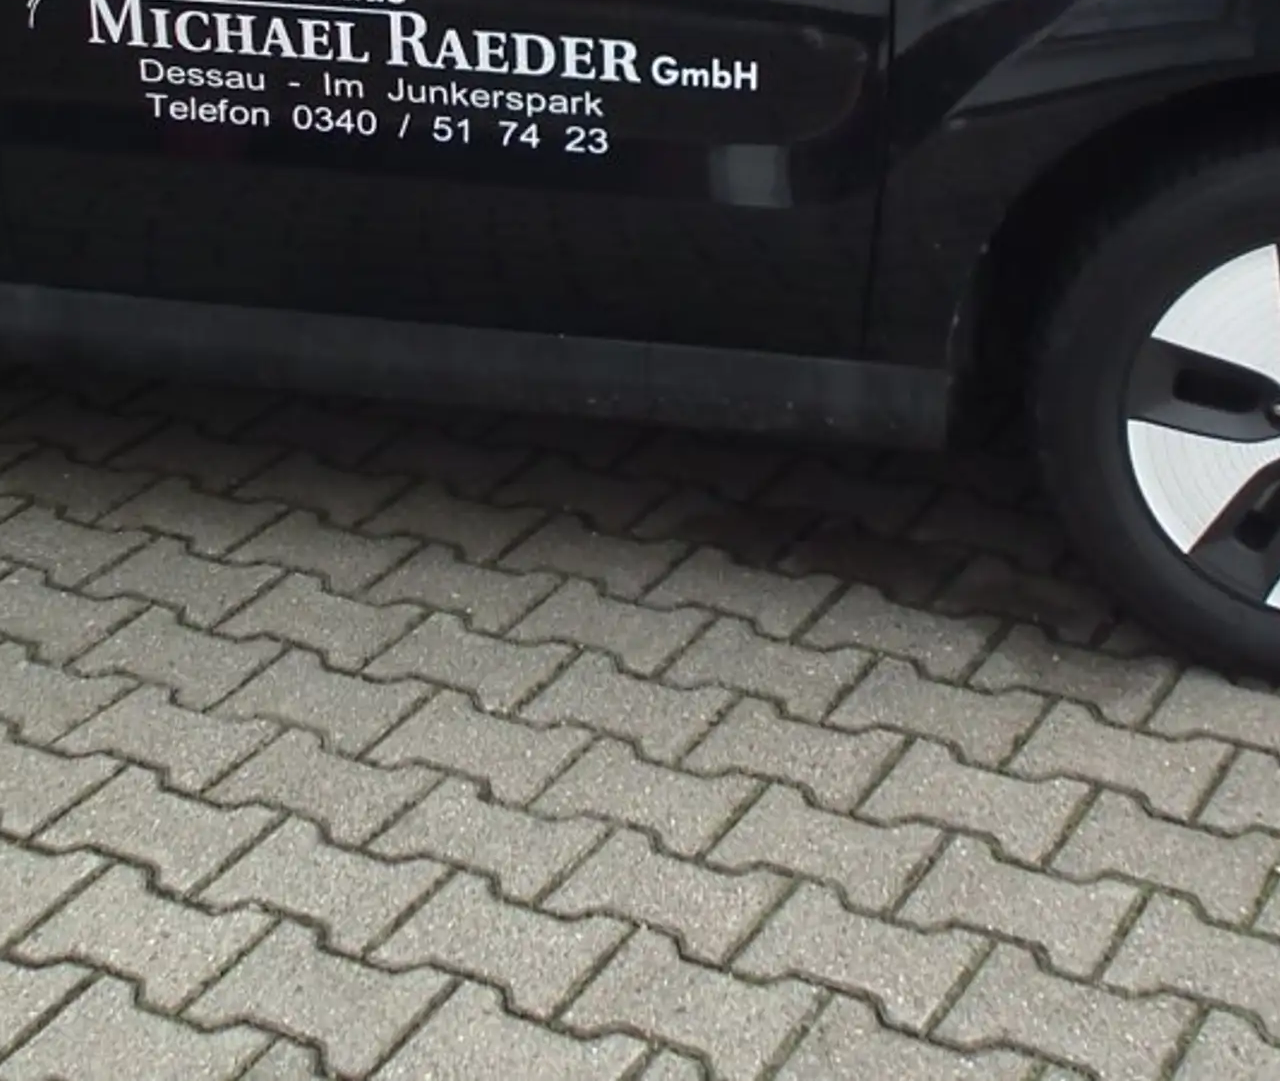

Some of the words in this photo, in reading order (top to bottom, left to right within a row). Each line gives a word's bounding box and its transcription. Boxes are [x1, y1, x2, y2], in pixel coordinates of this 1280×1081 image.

[386, 8, 641, 83] RAEDER
[651, 55, 758, 91] GmbH
[139, 58, 266, 91] Dessau
[323, 72, 365, 99] Im
[387, 77, 605, 118] Junkerspark
[145, 92, 270, 127] Telefon
[292, 105, 378, 136] 0340
[397, 112, 411, 139] /
[432, 116, 470, 144] 51
[497, 121, 541, 149] 74
[564, 126, 609, 155] 23
